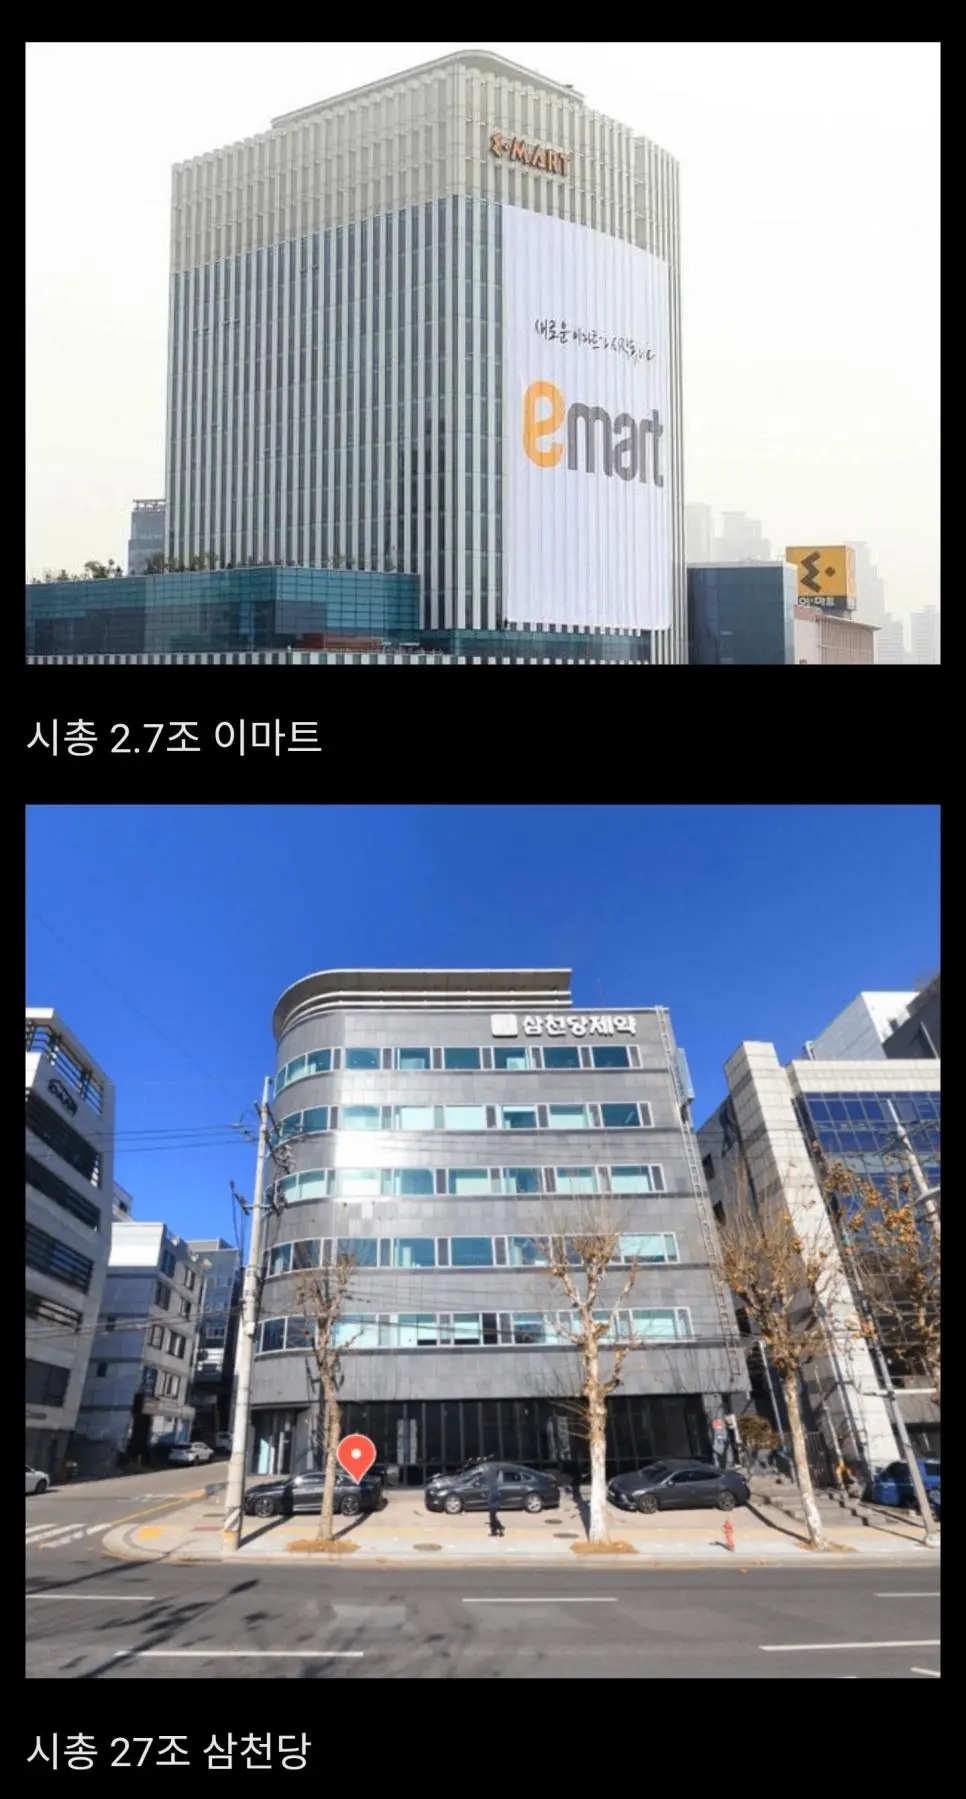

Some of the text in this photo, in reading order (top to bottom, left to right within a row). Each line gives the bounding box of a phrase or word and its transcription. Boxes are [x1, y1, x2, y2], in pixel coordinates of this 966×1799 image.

[534, 319, 571, 344] 새로운
[523, 381, 664, 488] emart
[522, 1014, 637, 1036] 삼천당제약
